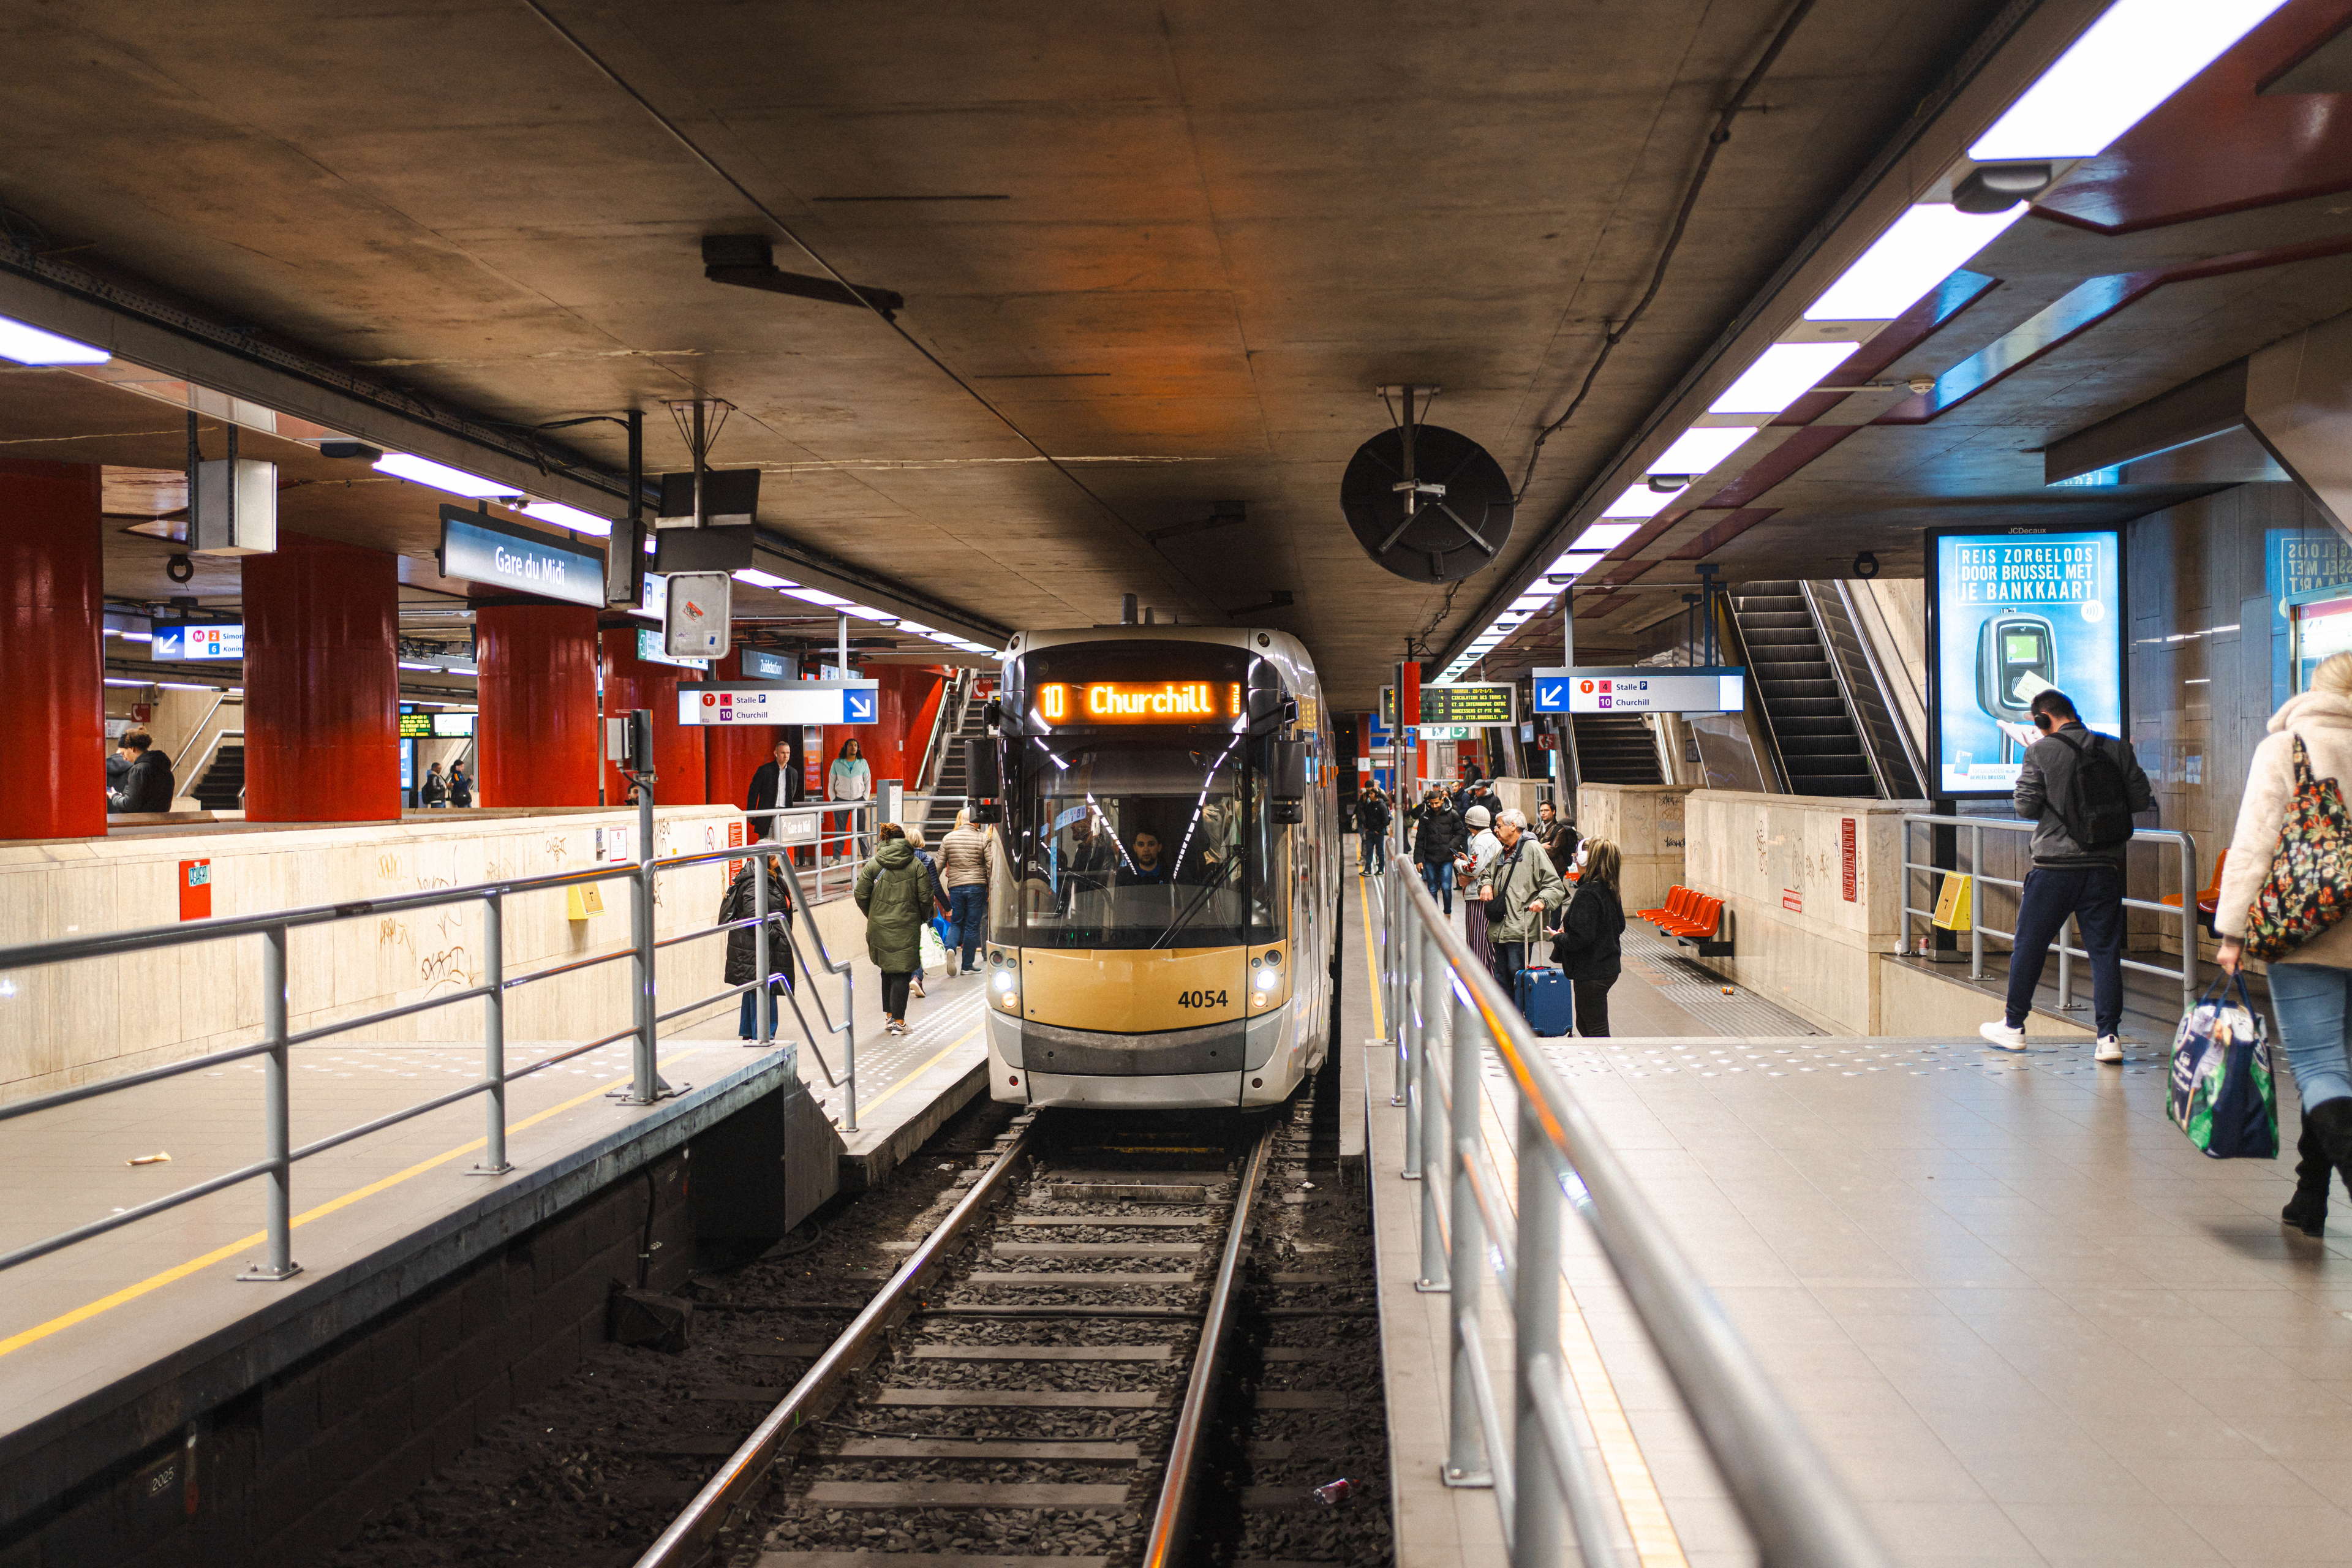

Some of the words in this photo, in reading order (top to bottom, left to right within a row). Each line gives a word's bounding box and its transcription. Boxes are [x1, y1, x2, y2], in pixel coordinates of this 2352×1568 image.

[1962, 549, 1996, 564] REIS
[2003, 548, 2093, 564] ZORGELOOS
[496, 546, 522, 576] Gare
[526, 552, 540, 579] du
[542, 557, 565, 586] Midi
[1962, 565, 1997, 581] DOOR
[2002, 564, 2061, 581] BRUSSEL
[2065, 564, 2092, 579] MET
[1961, 582, 1977, 601] JE
[1986, 581, 2094, 600] BANKKAART
[760, 659, 782, 675] Zuidstation
[1042, 685, 1063, 717] 10
[1090, 685, 1212, 714] Churchill
[722, 710, 731, 719] 10
[1178, 989, 1229, 1008] 4054
[152, 1466, 175, 1491] 2025
